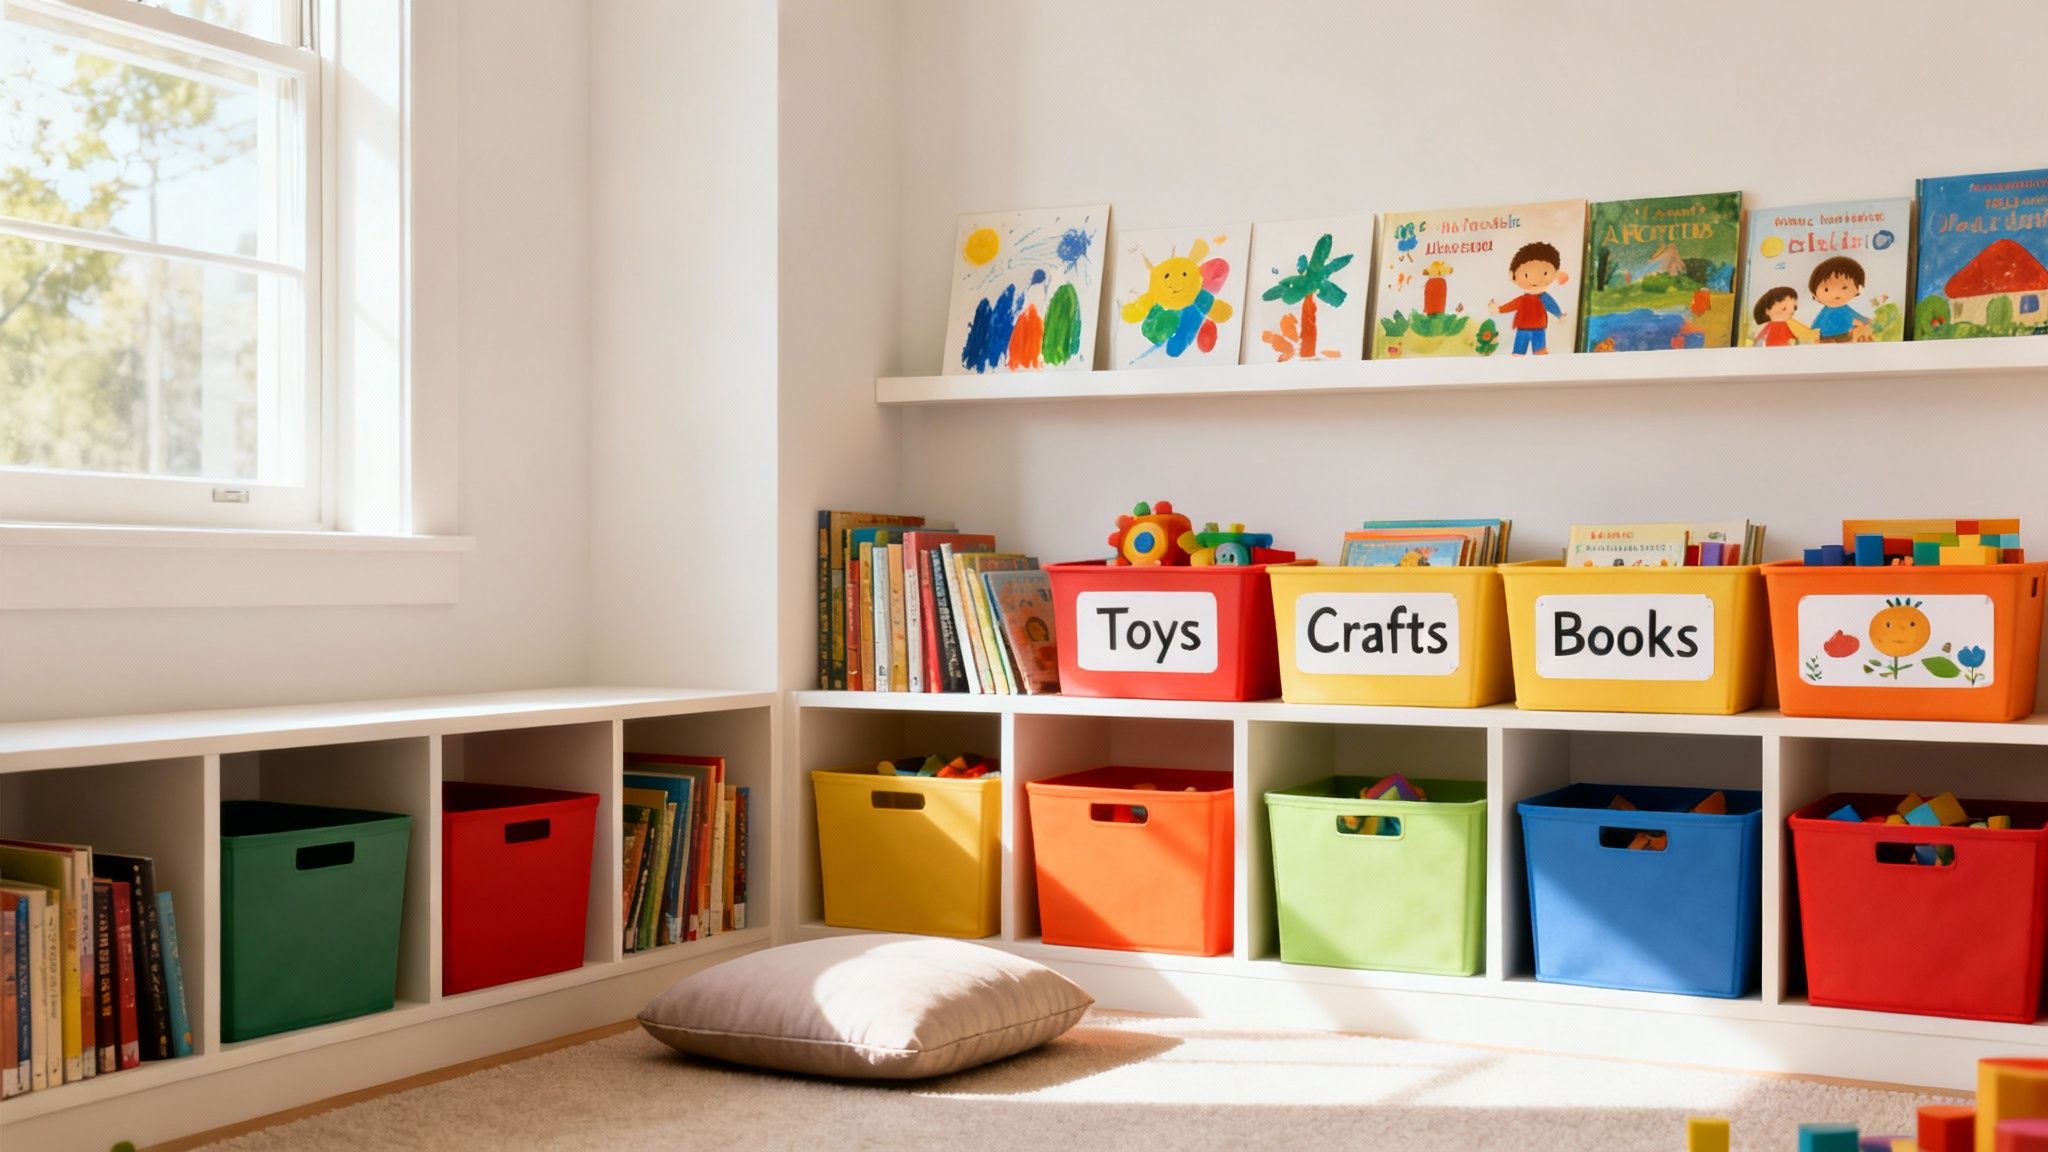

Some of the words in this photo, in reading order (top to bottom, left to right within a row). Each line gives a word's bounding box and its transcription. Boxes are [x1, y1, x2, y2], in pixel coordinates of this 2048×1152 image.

[1096, 607, 1202, 664] Toys
[1307, 605, 1448, 655] Crafts
[1554, 608, 1699, 658] Books
